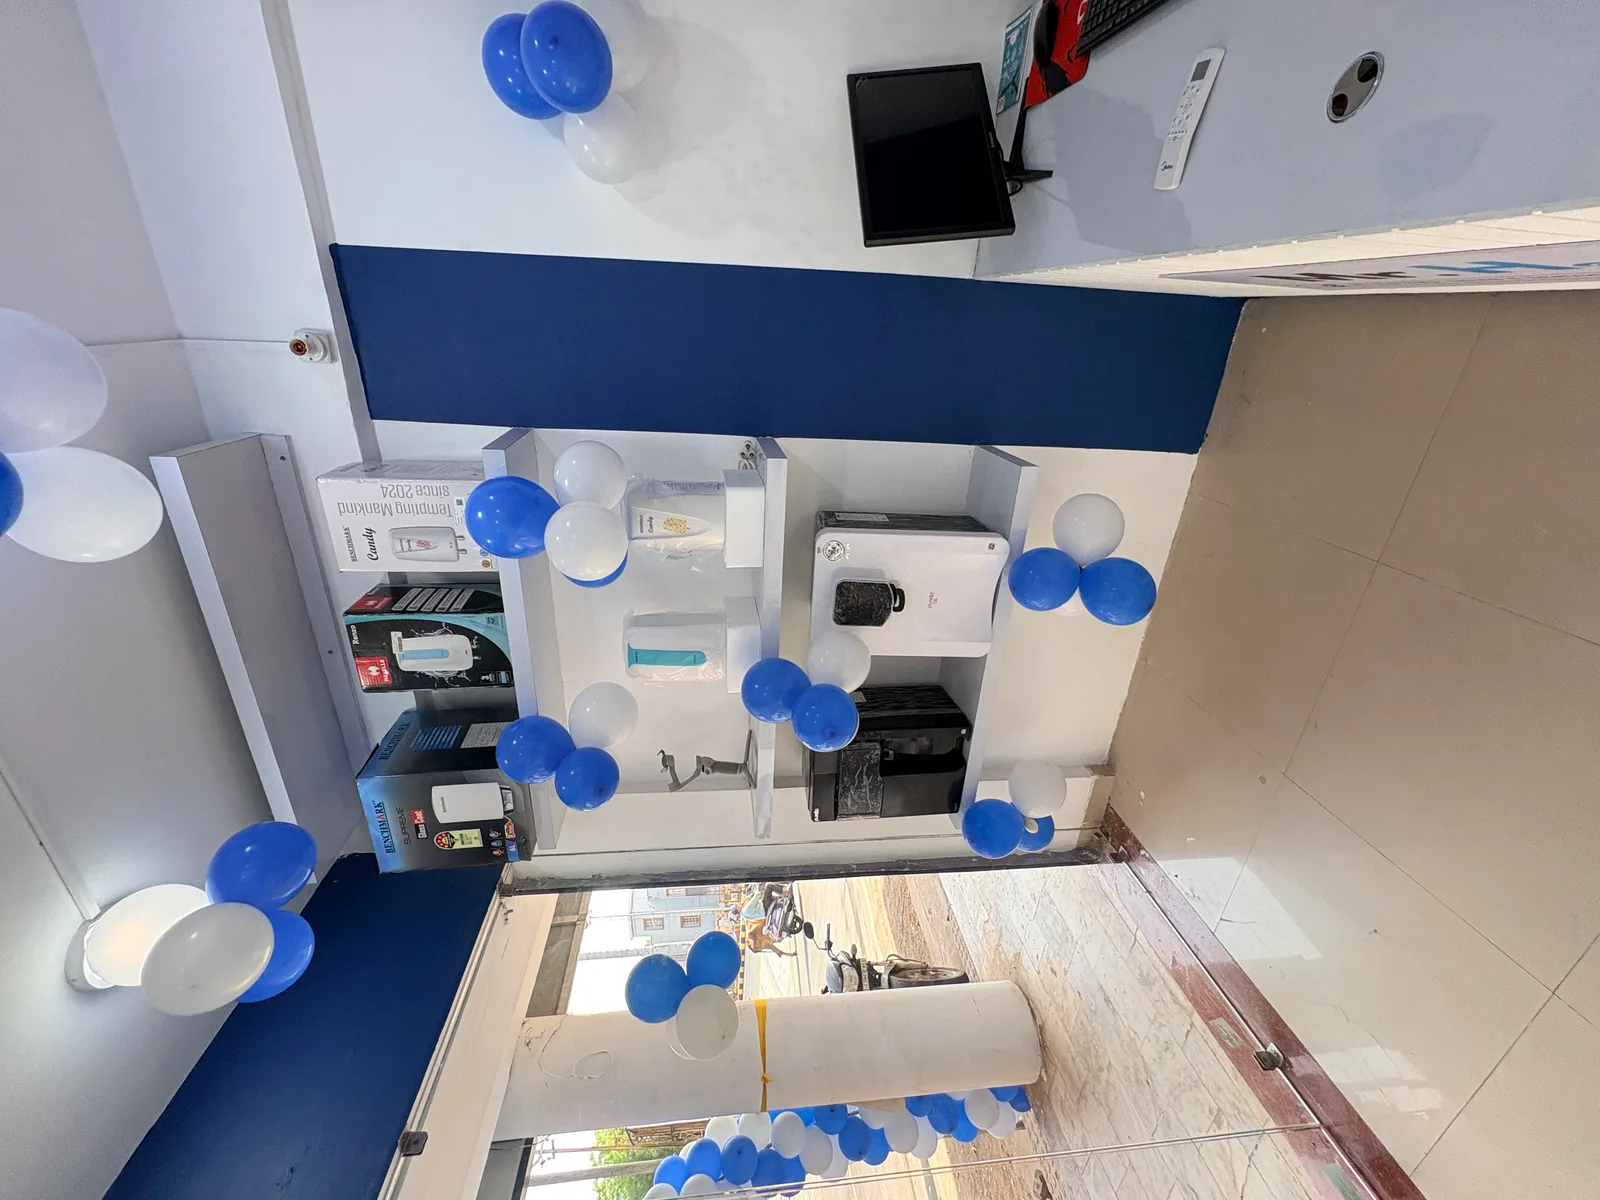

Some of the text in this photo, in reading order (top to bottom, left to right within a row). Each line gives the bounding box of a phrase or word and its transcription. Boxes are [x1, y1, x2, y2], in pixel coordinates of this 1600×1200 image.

[380, 484, 450, 498] since 2024
[337, 500, 454, 518] Tempting Mankind
[362, 526, 379, 561] Candy
[350, 624, 360, 645] Renzo
[372, 801, 396, 854] BENCHMARK
[396, 806, 412, 846] SUPREME
[414, 810, 424, 824] Coat
